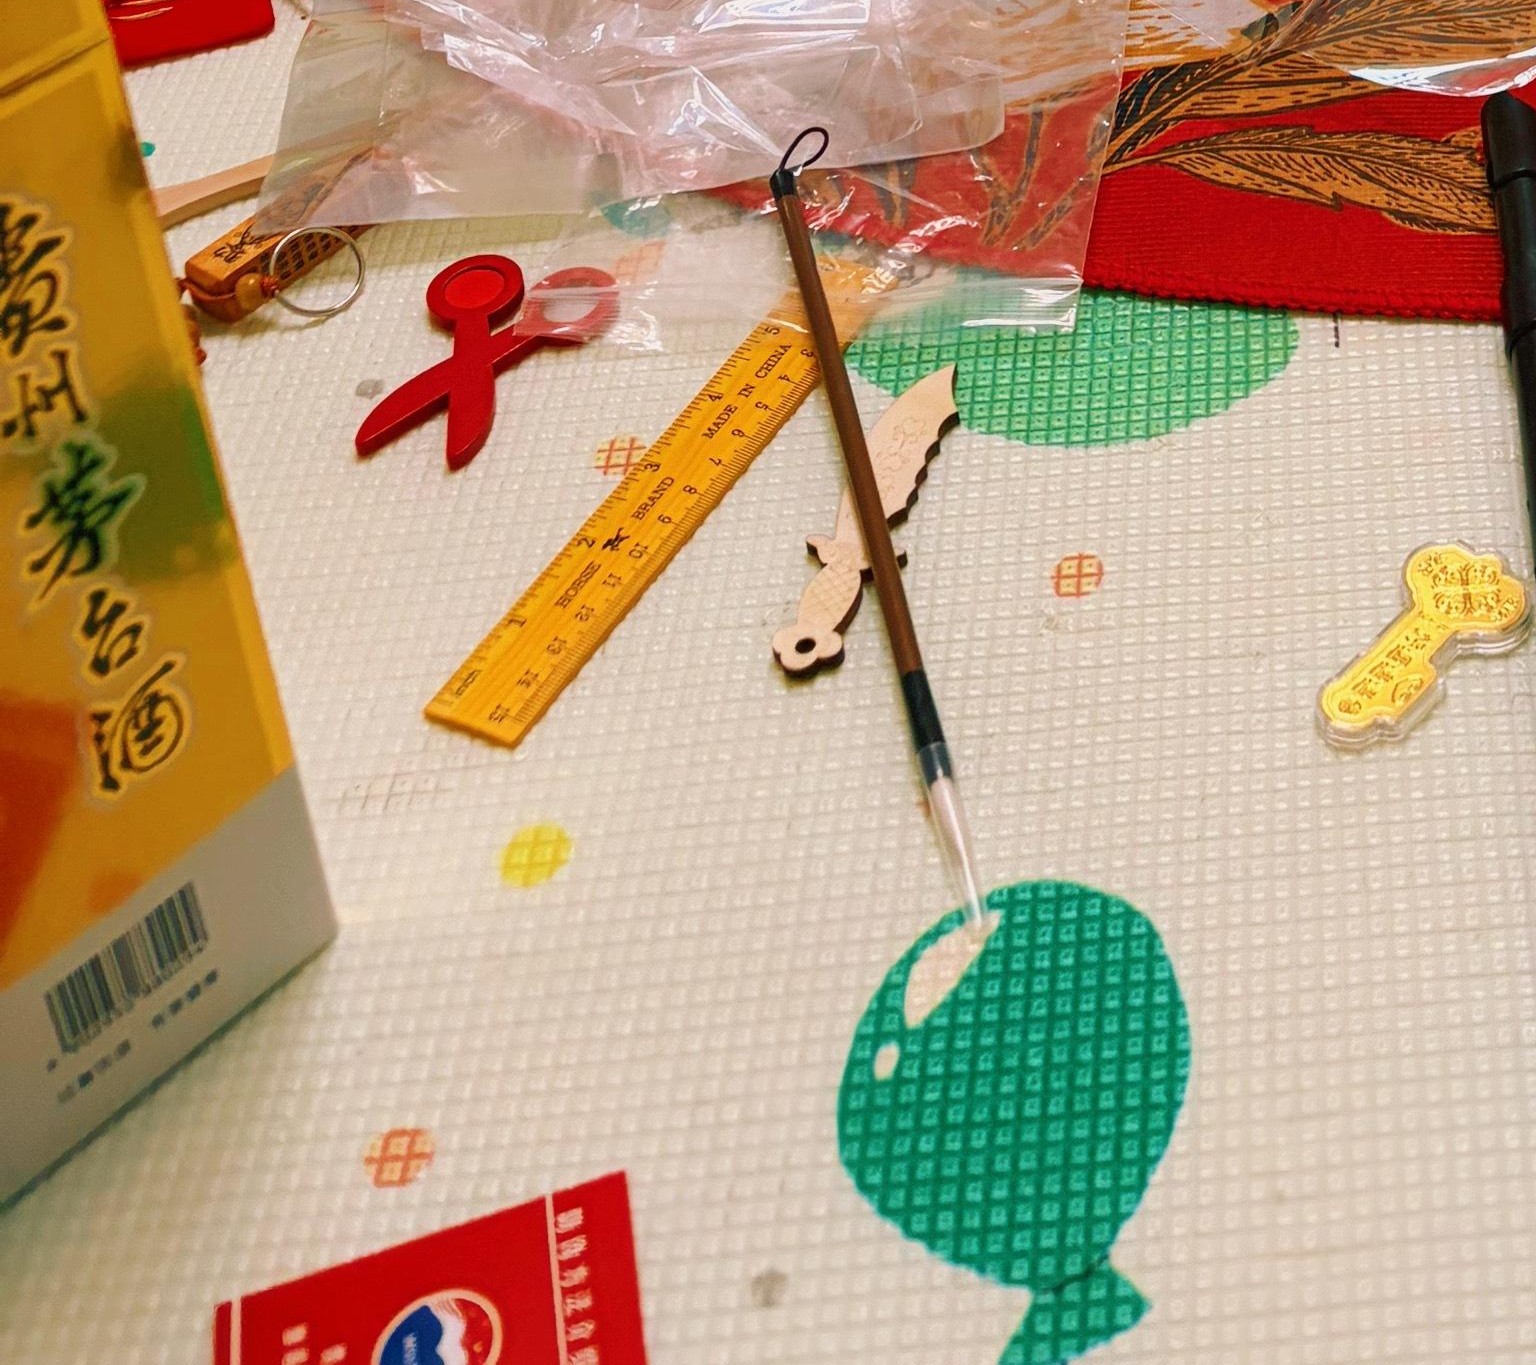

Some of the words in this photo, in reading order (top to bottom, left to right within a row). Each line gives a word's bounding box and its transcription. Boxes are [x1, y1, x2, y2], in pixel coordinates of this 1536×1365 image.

[555, 561, 601, 609] HORSE
[632, 476, 673, 520] BRAND
[703, 404, 737, 439] MADE
[738, 383, 754, 398] IN
[756, 345, 791, 378] CHINA
[629, 542, 647, 559] 10
